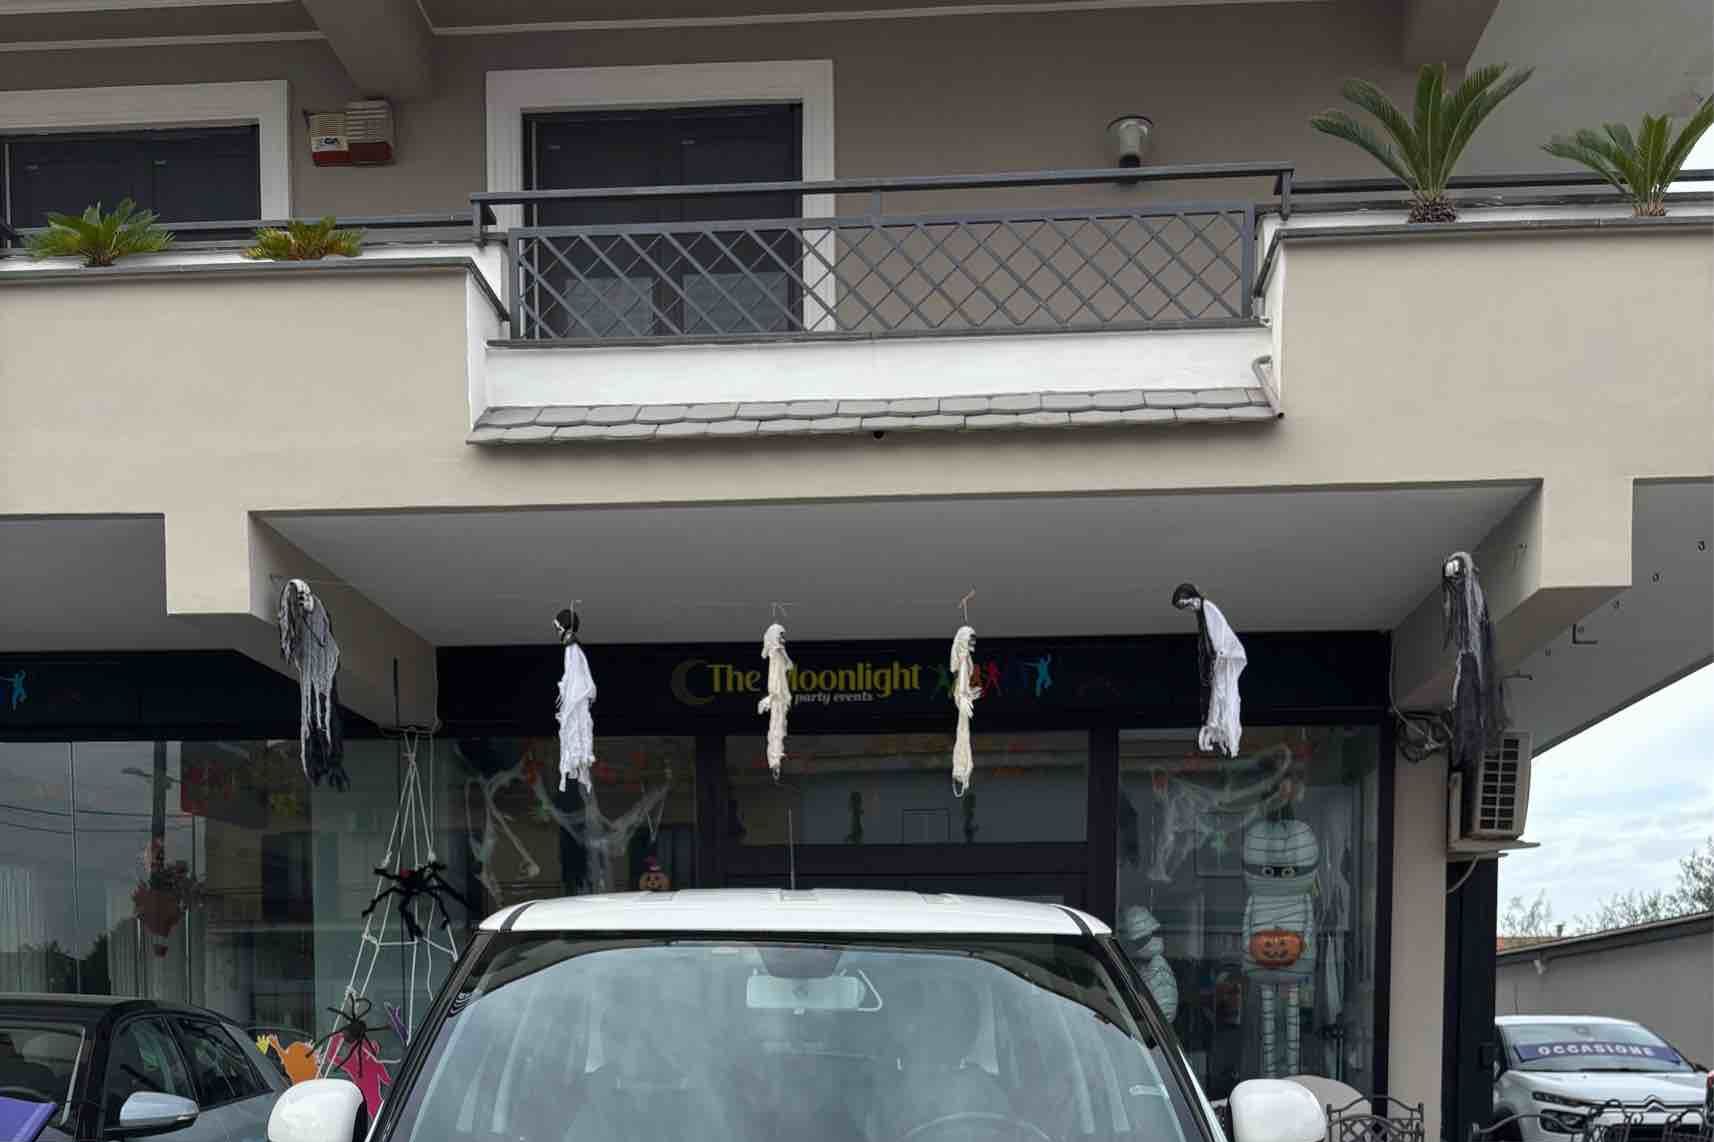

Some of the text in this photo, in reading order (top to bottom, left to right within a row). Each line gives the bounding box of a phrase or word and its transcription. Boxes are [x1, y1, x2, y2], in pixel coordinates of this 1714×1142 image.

[706, 664, 761, 692] The
[794, 691, 874, 705] party events
[1538, 1043, 1656, 1057] OCCASIONE
